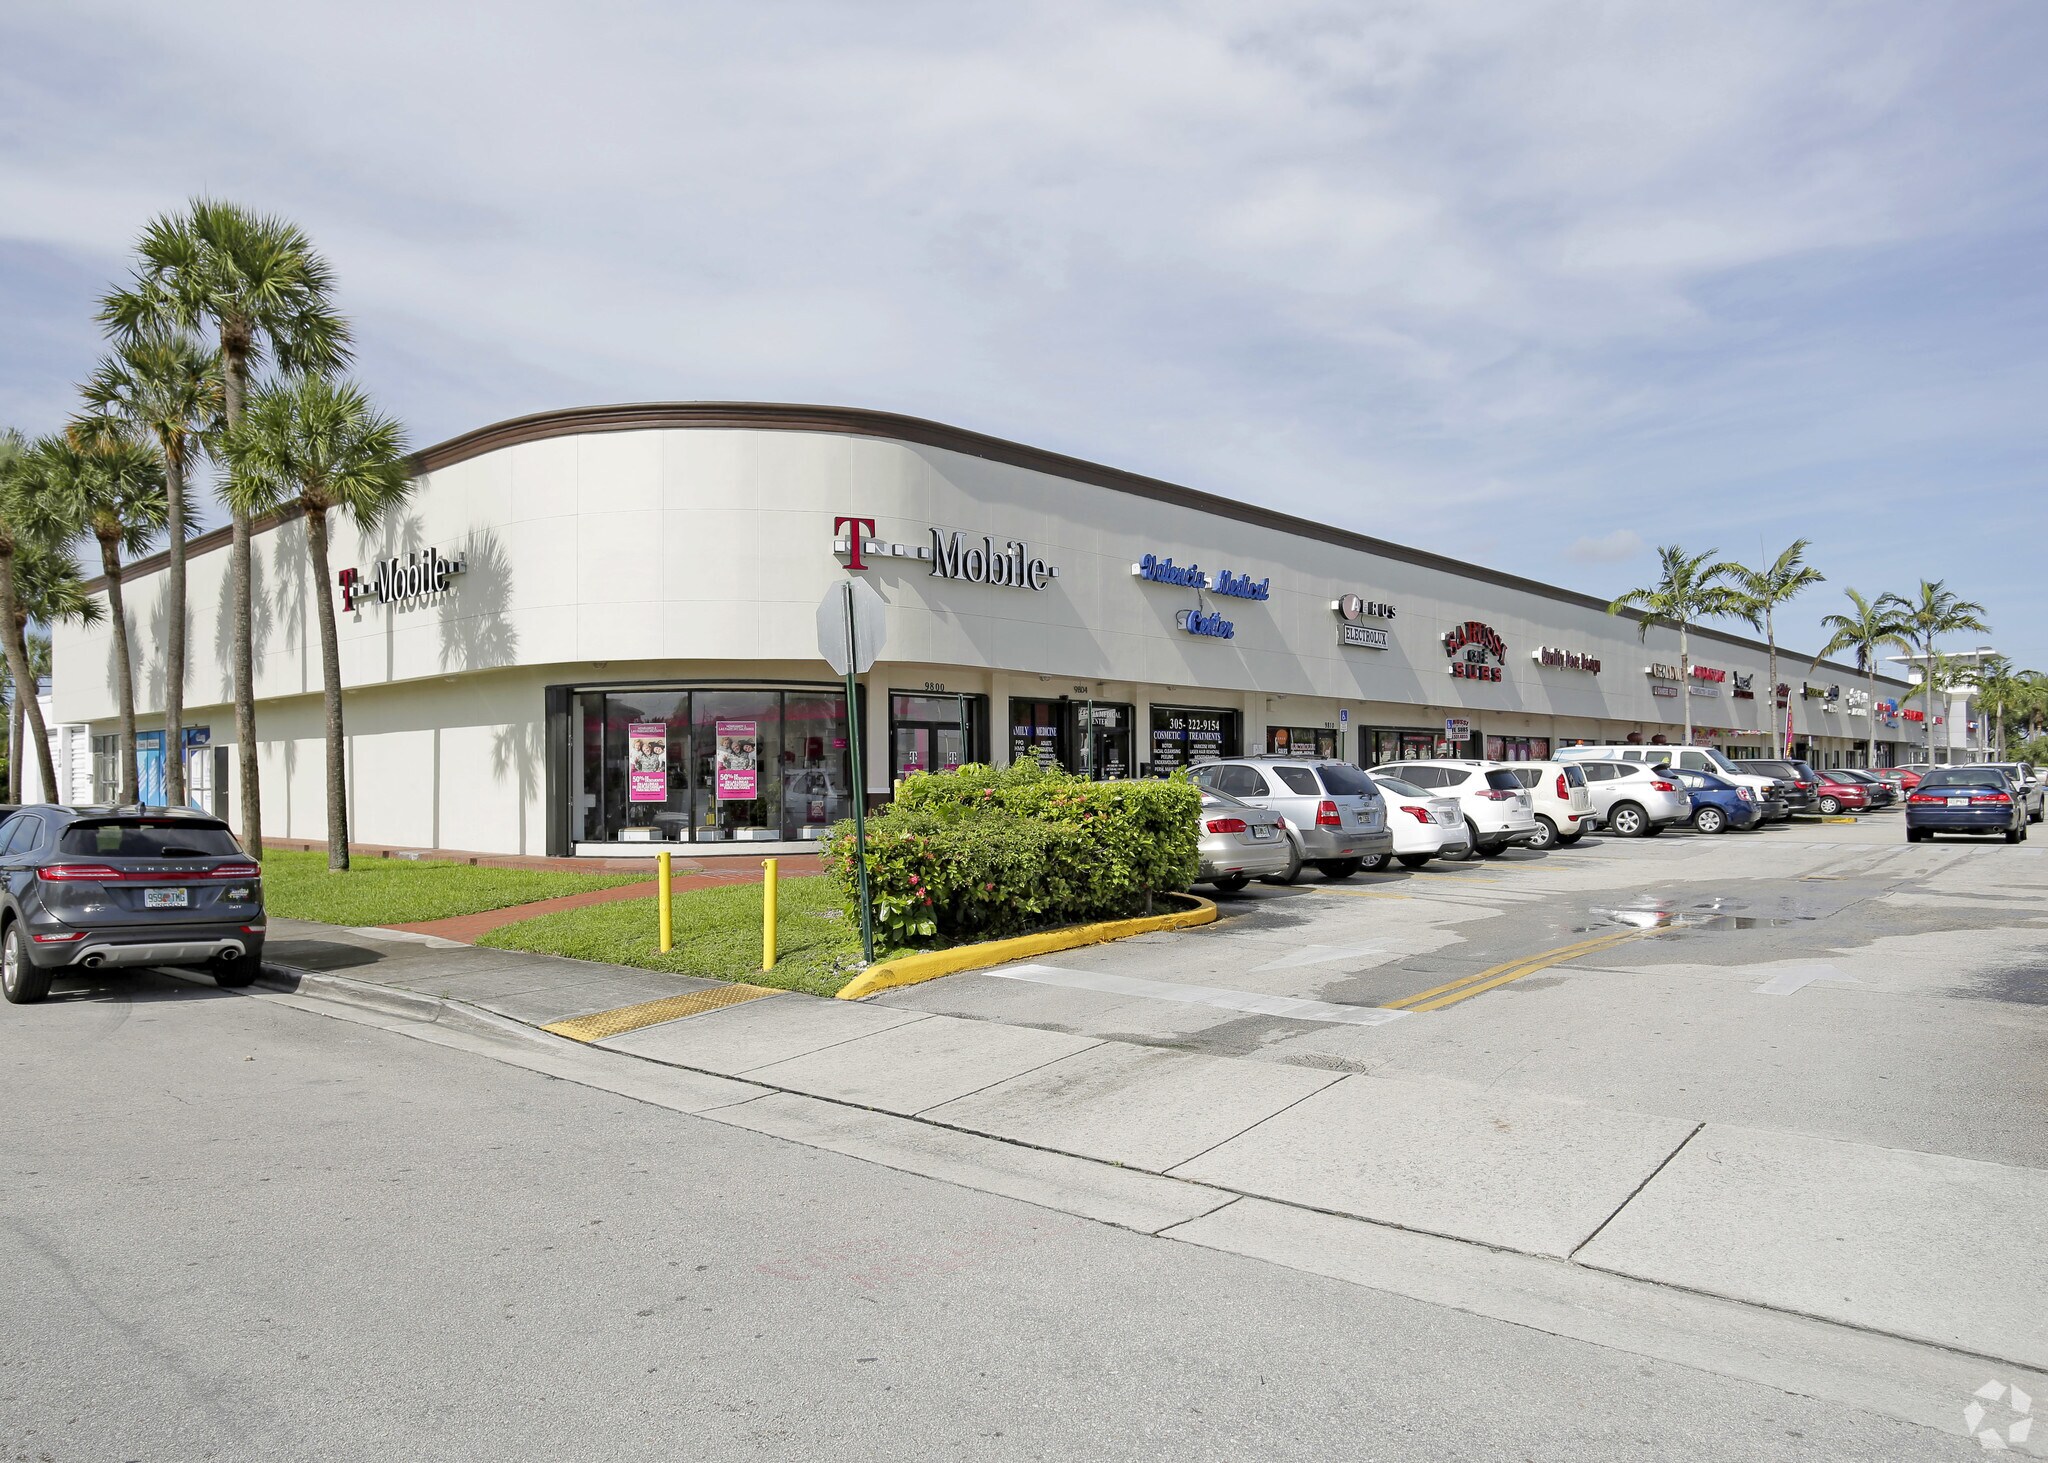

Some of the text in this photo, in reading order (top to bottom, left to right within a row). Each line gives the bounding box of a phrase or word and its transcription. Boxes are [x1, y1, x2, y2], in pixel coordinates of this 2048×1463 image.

[928, 527, 1049, 591] Mobile
[376, 547, 450, 605] Mobile
[1139, 553, 1270, 601] Valencia Medical
[1350, 596, 1397, 619] AERUS
[1185, 610, 1235, 640] Center
[1345, 626, 1387, 645] ELECTROLUX
[1445, 621, 1507, 666] SARUSSI
[1539, 646, 1564, 671] Quality
[1452, 662, 1502, 683] SUBS
[925, 682, 945, 691] 9800
[1073, 686, 1088, 694] 9804
[1035, 726, 1057, 737] MEDICINE
[1153, 730, 1221, 741] COSMETIC TREATMENTS
